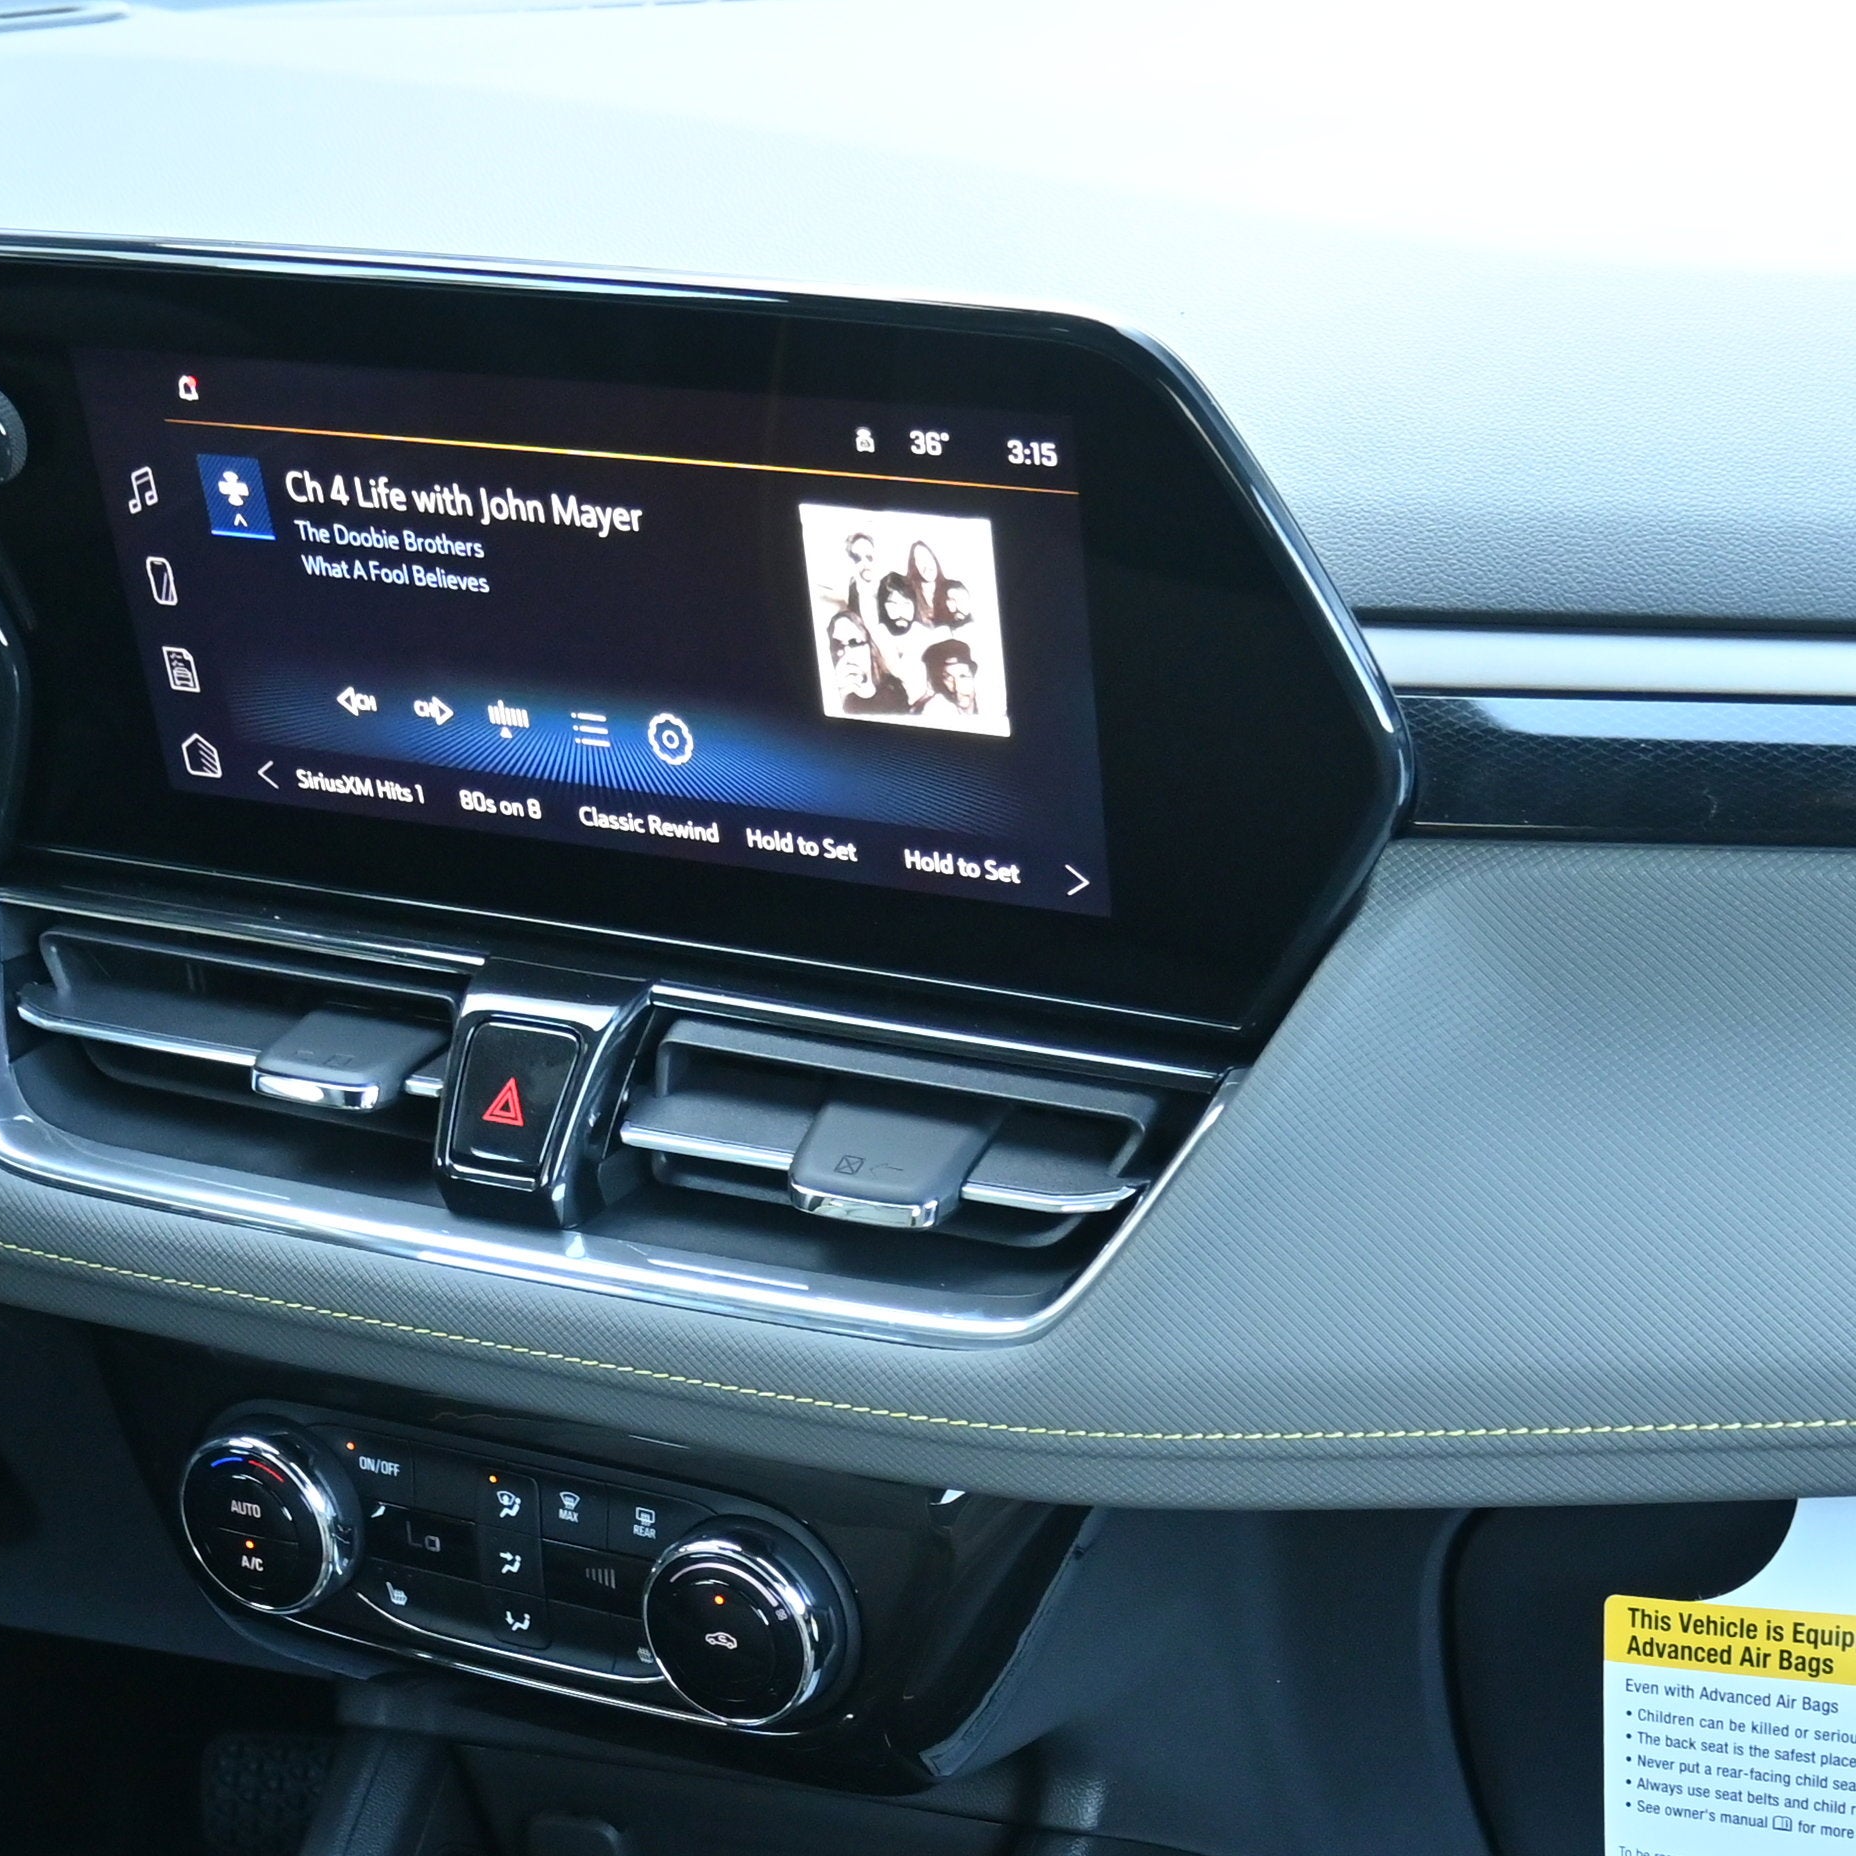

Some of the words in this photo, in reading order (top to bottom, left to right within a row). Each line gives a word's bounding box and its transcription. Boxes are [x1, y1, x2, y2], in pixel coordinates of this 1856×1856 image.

[909, 430, 950, 456] 36°
[1006, 439, 1058, 467] 3:15
[285, 470, 324, 505] Ch
[330, 474, 350, 506] 4
[353, 476, 408, 512] Life
[411, 483, 473, 517] with
[480, 487, 545, 526] John
[551, 493, 644, 538] Mayer
[294, 519, 331, 545] The
[334, 522, 400, 552] Doobie
[405, 530, 485, 559] Brothers
[301, 554, 351, 581] What
[353, 560, 368, 581] A
[369, 561, 409, 586] Fool
[414, 566, 490, 594] Believes
[295, 769, 374, 799] SiriusXM
[376, 778, 413, 804] Hits
[415, 784, 426, 805] 1
[459, 788, 498, 816] 80s
[500, 798, 526, 818] on
[528, 797, 542, 821] 8
[578, 805, 645, 836] Classic
[647, 814, 720, 845] Rewind
[746, 827, 795, 856] Hold
[797, 835, 820, 858] to
[822, 836, 858, 863] Set
[904, 848, 953, 876] Hold
[957, 856, 980, 879] to
[984, 858, 1022, 886] Set
[358, 1455, 400, 1478] ON/OFF
[230, 1499, 262, 1519] AUTO
[558, 1508, 579, 1523] MAX
[633, 1524, 657, 1539] REAR
[241, 1554, 264, 1572] A/C
[1627, 1607, 1672, 1632] This
[1678, 1612, 1758, 1640] Vehicle
[1766, 1619, 1785, 1642] is
[1626, 1635, 1733, 1665] Advanced
[1740, 1646, 1772, 1669] Air
[1778, 1649, 1834, 1678] Bags
[1626, 1679, 1659, 1695] Even
[1664, 1682, 1695, 1699] with
[1699, 1686, 1771, 1707] Advanced
[1776, 1694, 1797, 1709] Air
[1802, 1697, 1839, 1716] Bags
[1638, 1708, 1694, 1726] Children
[1699, 1716, 1724, 1730] can
[1729, 1719, 1745, 1732] be
[1751, 1721, 1789, 1737] killed
[1794, 1727, 1809, 1739] or
[1637, 1731, 1661, 1746] The
[1665, 1734, 1696, 1750] back
[1700, 1741, 1728, 1754] seat
[1733, 1744, 1744, 1756] is
[1749, 1745, 1770, 1759] the
[1774, 1748, 1816, 1764] safest
[1821, 1752, 1856, 1768] place
[1637, 1754, 1674, 1771] Never
[1679, 1761, 1700, 1775] put
[1704, 1765, 1712, 1776] a
[1716, 1766, 1791, 1786] rear-facing
[1795, 1774, 1828, 1790] child
[1636, 1777, 1683, 1796] Always
[1687, 1786, 1710, 1798] use
[1715, 1788, 1743, 1802] seat
[1747, 1791, 1780, 1807] belts
[1784, 1798, 1809, 1810] and
[1813, 1800, 1846, 1815] child
[1637, 1799, 1661, 1814] See
[1665, 1806, 1716, 1822] owner's
[1720, 1812, 1768, 1829] manual
[1798, 1820, 1816, 1834] for
[1821, 1824, 1855, 1839] more
